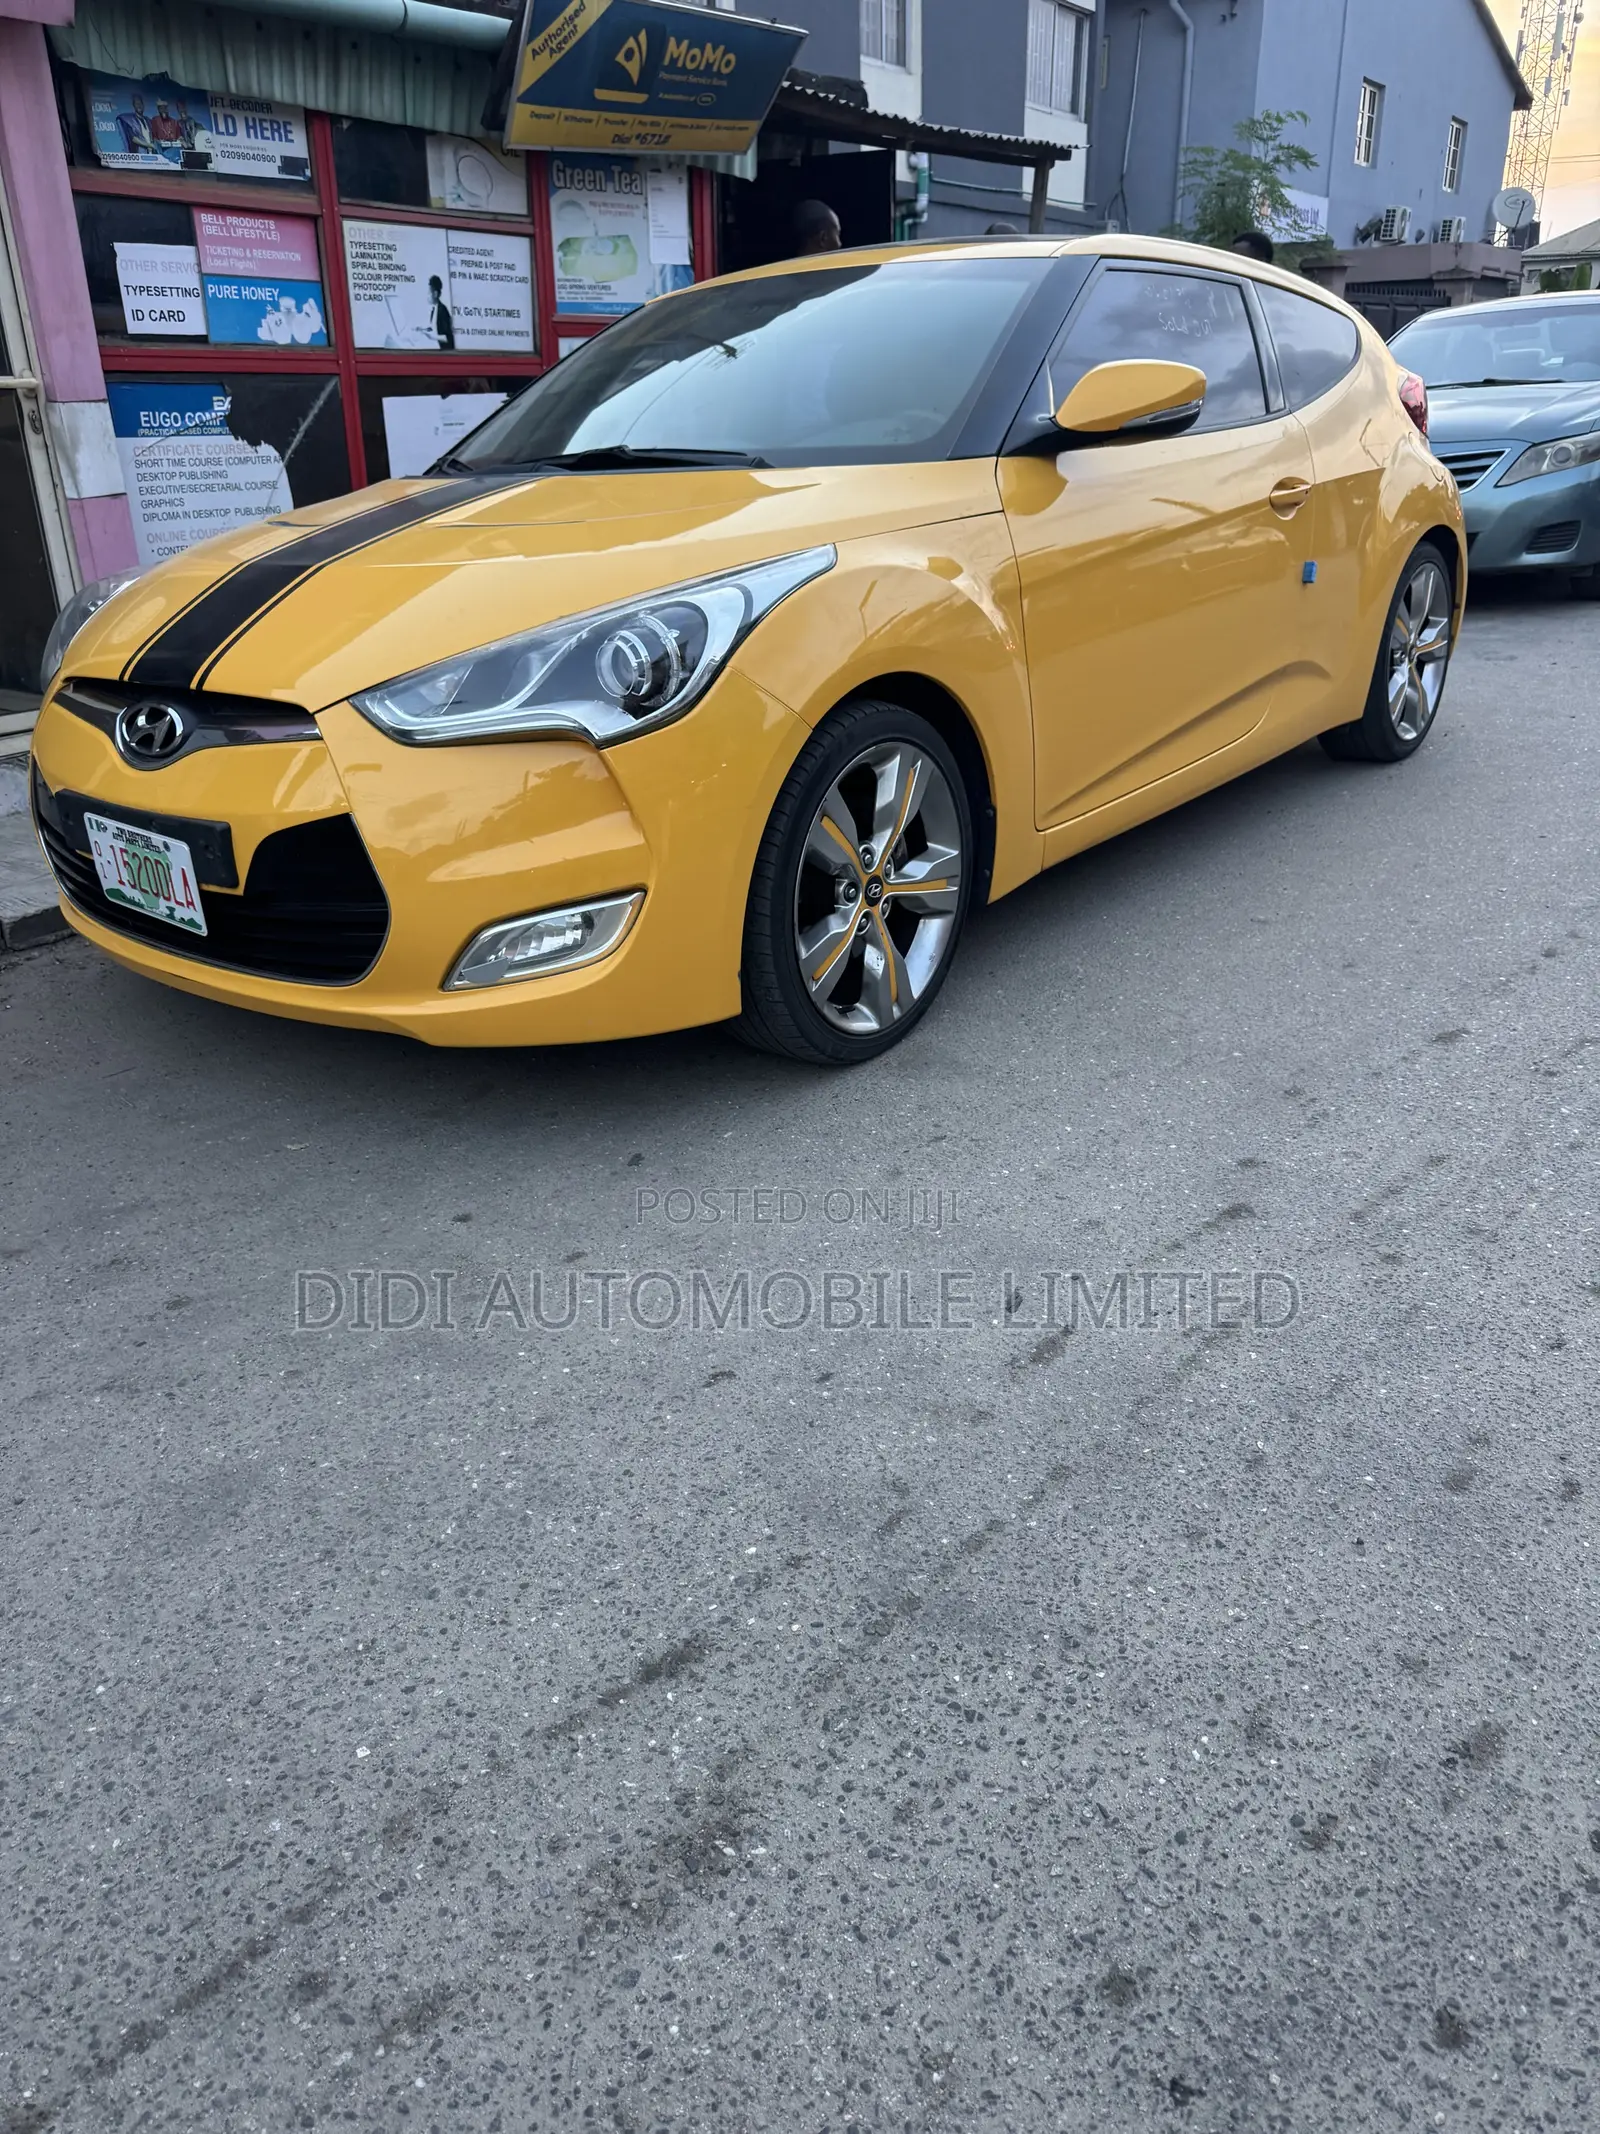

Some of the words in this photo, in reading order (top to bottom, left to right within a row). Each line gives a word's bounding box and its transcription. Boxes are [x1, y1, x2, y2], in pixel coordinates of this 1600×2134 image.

[532, 0, 586, 61] Authorised
[549, 23, 578, 59] Agent
[663, 36, 736, 74] MoMo
[229, 98, 273, 114] DECODER
[245, 116, 295, 144] HERE
[611, 133, 633, 145] Dial
[552, 159, 607, 192] Green
[611, 165, 644, 195] Tea
[201, 213, 225, 225] BELL
[226, 217, 276, 230] PRODUCTS
[203, 225, 230, 237] (BELL
[232, 228, 281, 242] LIFESTYLE)
[349, 227, 384, 240] OTHER
[349, 240, 397, 252] TYPESETTING
[205, 245, 245, 258] TICKETING
[253, 248, 302, 262] RESERVATION
[350, 251, 394, 261] LAMINATION
[120, 258, 158, 273] OTHER
[206, 257, 229, 269] (Local
[351, 261, 377, 271] SPIRAL
[378, 262, 407, 272] BINDING
[460, 259, 483, 269] PREPAID
[489, 261, 503, 270] POST
[352, 272, 383, 281] COLOUR
[383, 274, 416, 283] PRINTING
[124, 285, 201, 298] TYPESETTING
[207, 284, 240, 299] PURE
[242, 287, 280, 301] HONEY
[353, 282, 397, 292] PHOTOCOPY
[354, 293, 362, 301] ID
[363, 294, 383, 302] CARD
[131, 309, 145, 322] ID
[148, 309, 186, 323] CARD
[484, 307, 521, 319] STARTIMES
[139, 411, 182, 427] EUGO
[184, 411, 230, 427] COMP
[133, 444, 203, 458] CERTIFICATE
[134, 458, 164, 469] SHORT
[165, 457, 187, 468] TIME
[188, 457, 223, 467] COURSE
[225, 456, 272, 467] (COMPUTER
[136, 471, 178, 483] DESKTOP
[178, 470, 228, 481] PUBLISHING
[139, 482, 244, 496] EXECUTIVE/SECRETARIAL
[244, 481, 279, 491] COURSE
[141, 497, 185, 509] GRAPHICS
[142, 510, 182, 523] DIPLOMA
[182, 510, 191, 520] IN
[192, 508, 231, 519] DESKTOP
[234, 505, 282, 517] PUBLISHING
[147, 530, 187, 544] ONLINE
